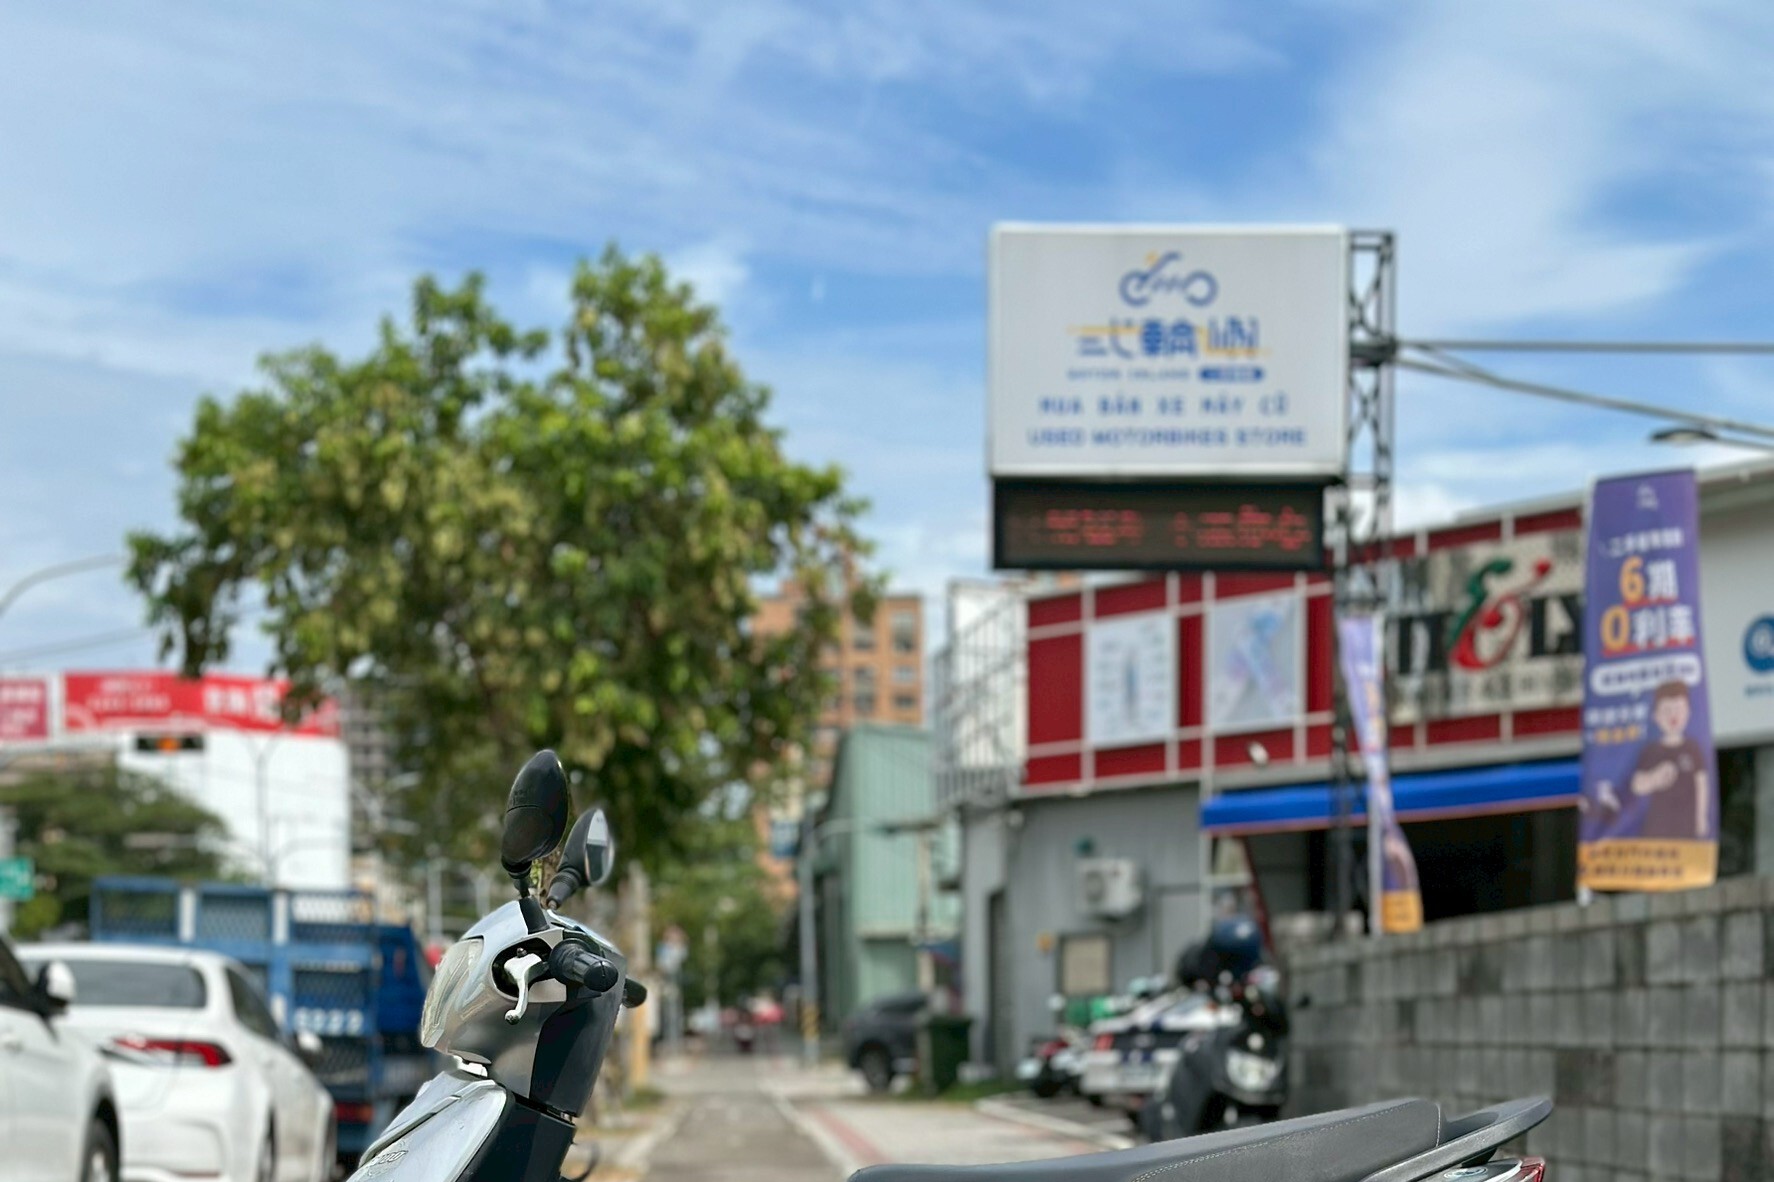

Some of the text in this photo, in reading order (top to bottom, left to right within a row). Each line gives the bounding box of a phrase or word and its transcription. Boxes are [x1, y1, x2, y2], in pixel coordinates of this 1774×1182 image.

[1028, 427, 1307, 447] USED MOTORBIKES STORE
